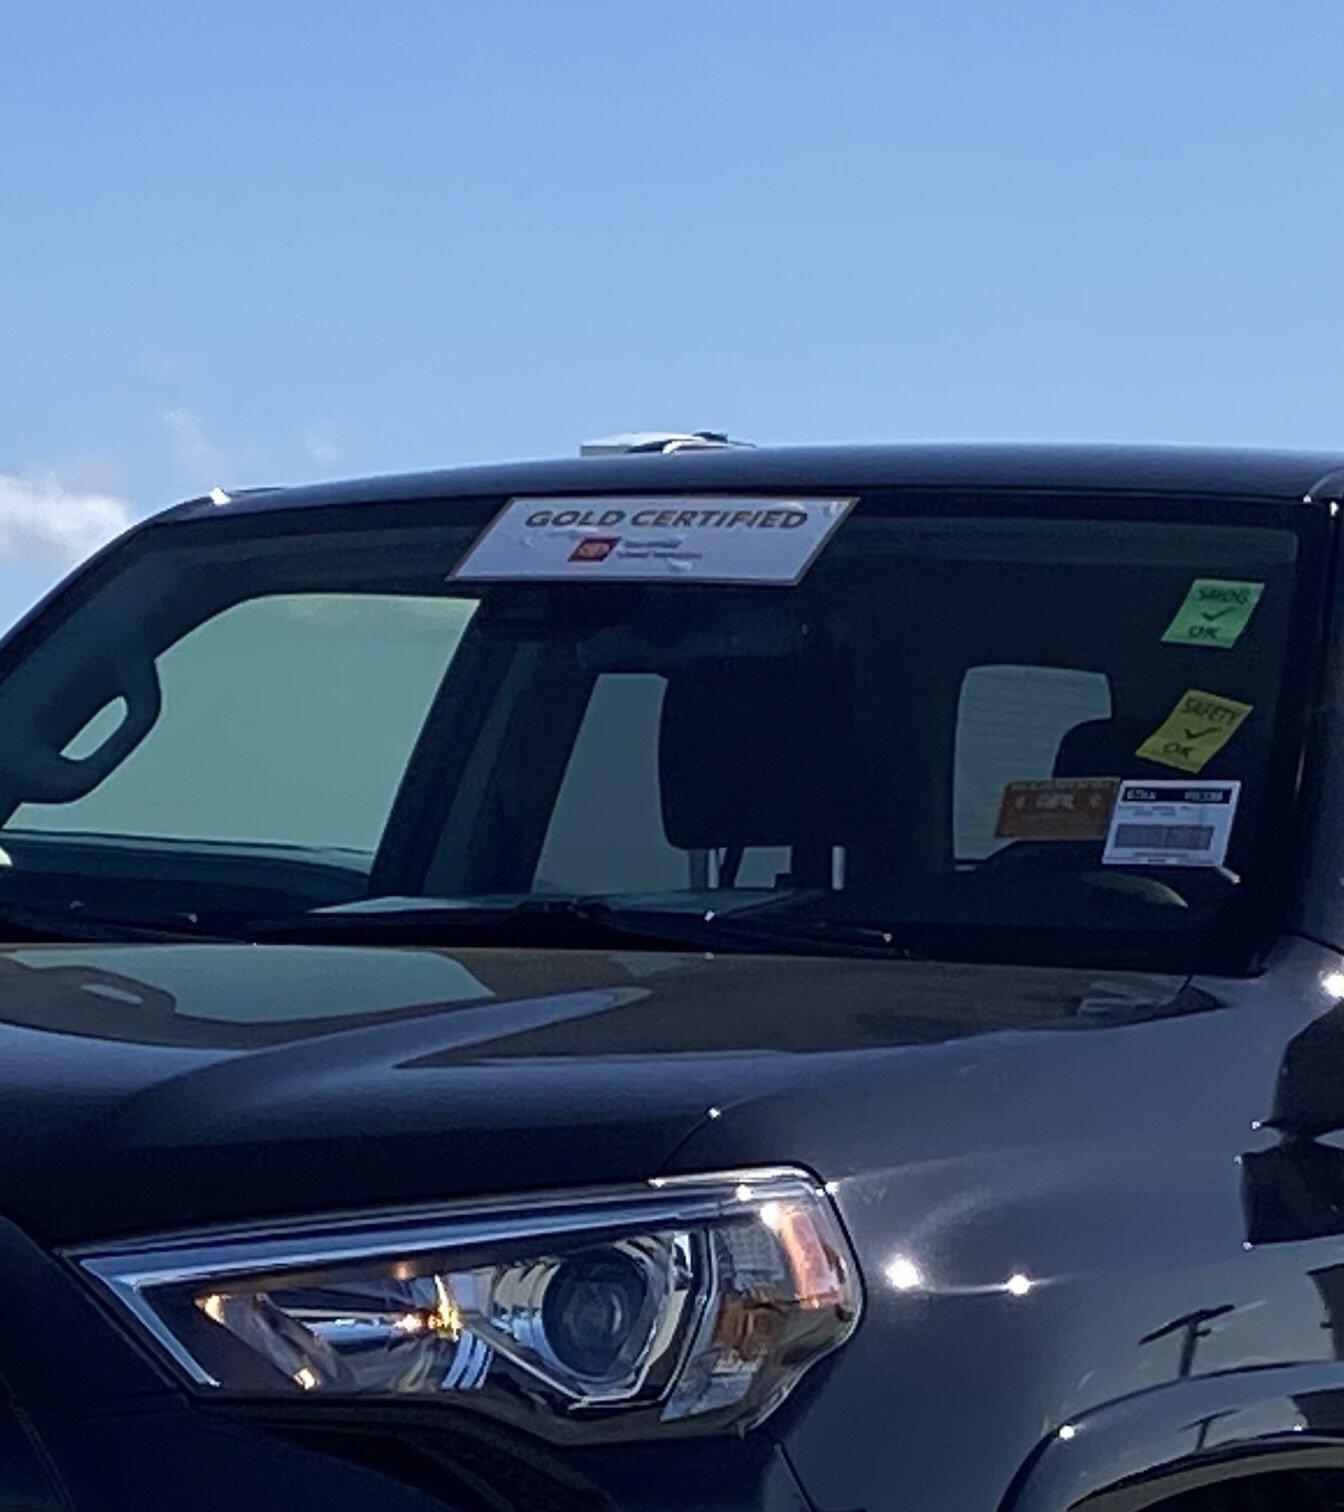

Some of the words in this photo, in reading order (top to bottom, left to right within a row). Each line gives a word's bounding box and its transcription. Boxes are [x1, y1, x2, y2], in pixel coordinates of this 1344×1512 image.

[525, 510, 626, 527] GOLD
[630, 509, 809, 529] CERTIFIED
[1188, 625, 1219, 639] OK
[1162, 742, 1194, 758] OK
